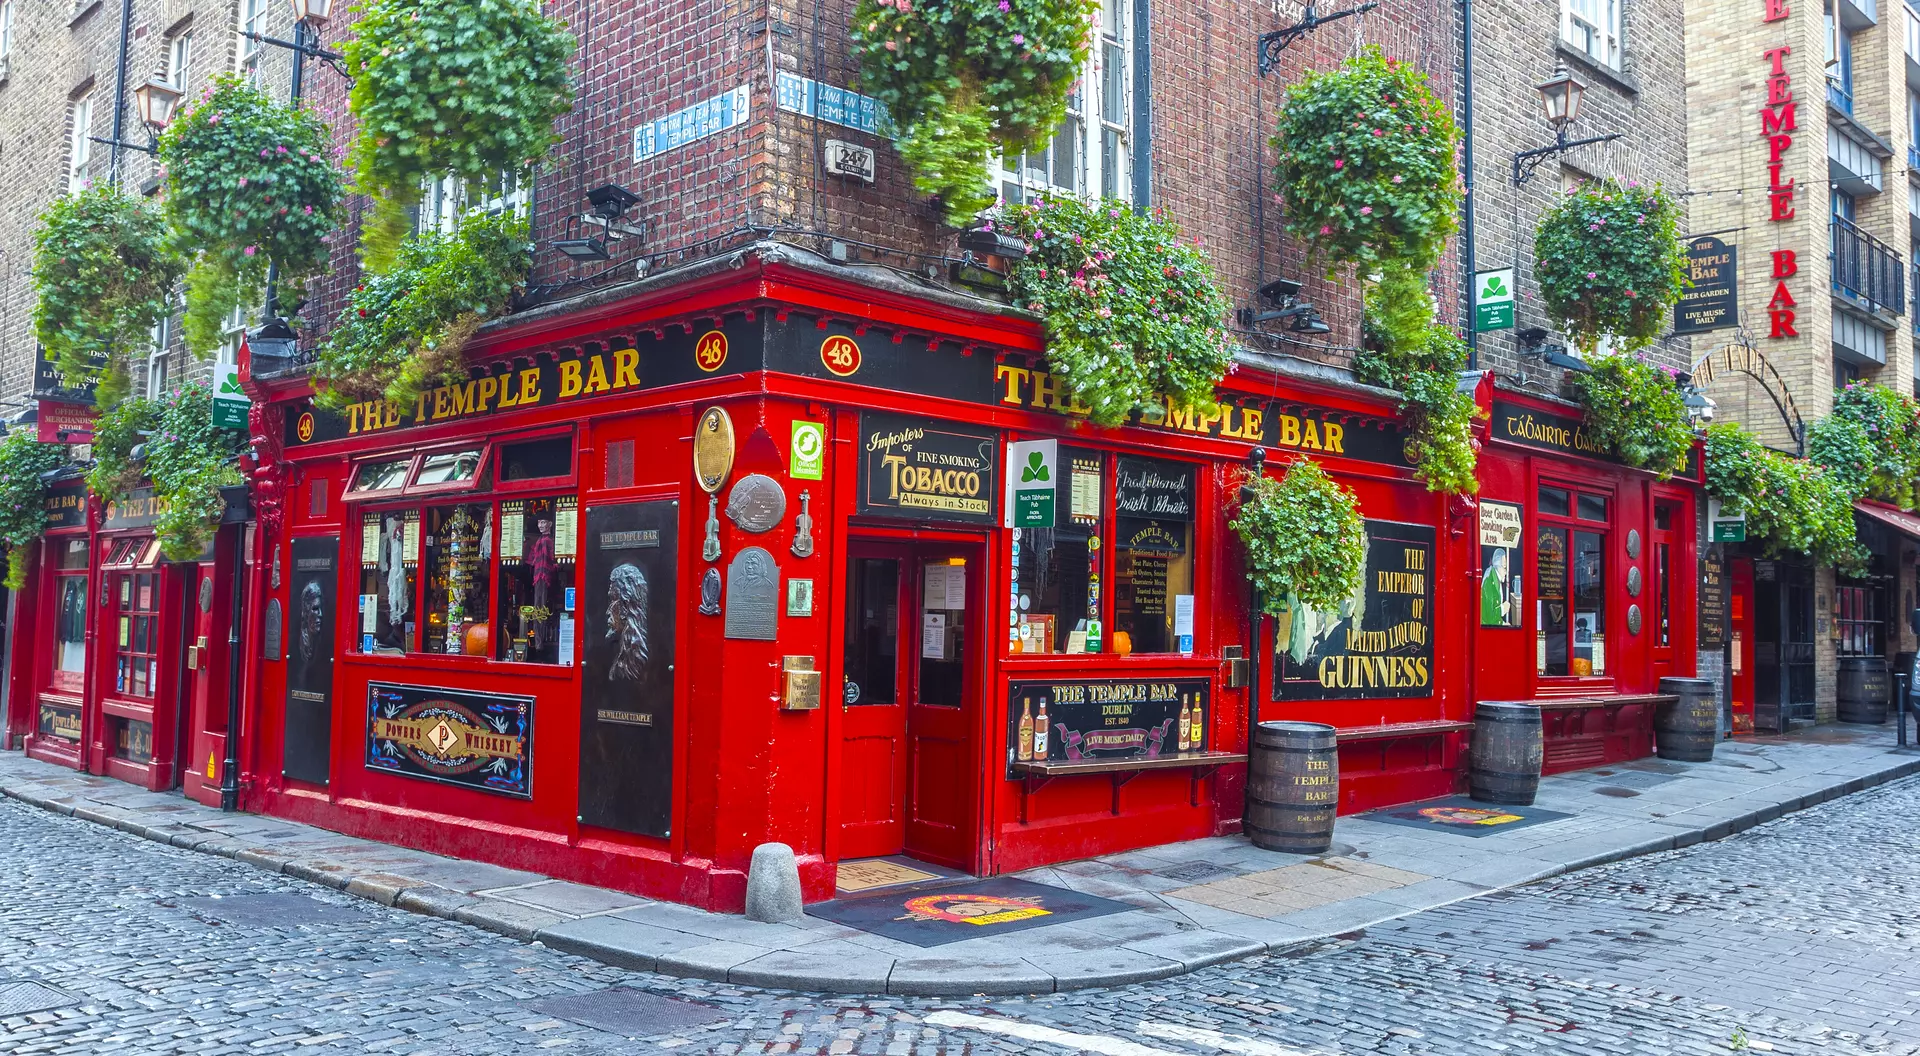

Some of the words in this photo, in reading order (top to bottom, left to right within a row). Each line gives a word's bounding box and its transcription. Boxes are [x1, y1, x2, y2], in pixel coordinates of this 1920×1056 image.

[738, 96, 746, 114] 2
[844, 96, 857, 109] AN
[701, 116, 720, 134] BAR
[1759, 46, 1799, 222] TEMPLE
[1695, 242, 1713, 250] THE
[1691, 268, 1719, 281] BAR
[1699, 288, 1730, 298] GARDEN
[1766, 249, 1799, 340] BAR
[1685, 311, 1701, 320] LIVE
[1702, 309, 1726, 318] MUSIC
[1695, 316, 1716, 325] DAILY
[700, 338, 722, 366] 48
[827, 340, 854, 368] 48
[81, 375, 102, 384] USIC
[347, 400, 402, 434] THE
[415, 368, 542, 423] TEMPLE
[558, 348, 641, 399] BAR
[44, 415, 96, 425] MERCHANDIS
[54, 407, 87, 416] OFFICIAL
[299, 415, 312, 438] 48
[1122, 391, 1265, 442] EMPLE
[1279, 413, 1345, 454] BAR
[866, 427, 924, 455] Importers
[902, 443, 913, 453] OF
[916, 451, 938, 464] FINE
[939, 453, 980, 469] SMOKING
[881, 453, 980, 500] TOBACCO
[61, 494, 77, 508] BAR
[122, 499, 144, 518] THE
[148, 496, 171, 515] TEM
[901, 493, 940, 507] Always
[944, 498, 954, 508] in
[957, 498, 987, 512] Stock
[1481, 506, 1493, 518] Beer
[1494, 507, 1513, 521] Garden
[1481, 518, 1503, 534] Smoking
[600, 534, 614, 543] THE
[614, 532, 642, 542] TEMPLE
[643, 531, 658, 541] BAR
[1130, 527, 1163, 546] TEMPLE
[1164, 531, 1179, 551] BAR
[1485, 532, 1498, 544] Area
[1129, 548, 1155, 556] Traditional
[1405, 548, 1425, 571] THE
[1378, 571, 1425, 595] EMPEROR
[1412, 598, 1425, 619] OF
[1345, 628, 1387, 653] MALTED
[1388, 620, 1428, 648] LIQUORS
[1318, 655, 1429, 689] GUINNESS
[1052, 685, 1085, 704] THE
[1088, 684, 1147, 704] TEMPLE
[1149, 683, 1179, 702] BAR
[606, 711, 630, 721] WILLIAM
[630, 713, 651, 722] TEMPLE
[1101, 704, 1133, 715] DUBLIN
[51, 711, 70, 730] TEMPLE
[1118, 717, 1129, 725] 1840
[386, 722, 422, 740] POWERS
[439, 725, 449, 746] P
[465, 732, 512, 753] WHISKEY
[1086, 735, 1102, 746] LIVE
[1103, 734, 1124, 745] MUSIC
[1125, 733, 1145, 743] DAILY
[1305, 761, 1329, 770] THE
[1292, 776, 1336, 786] TEMPLE
[1305, 791, 1328, 801] BAR
